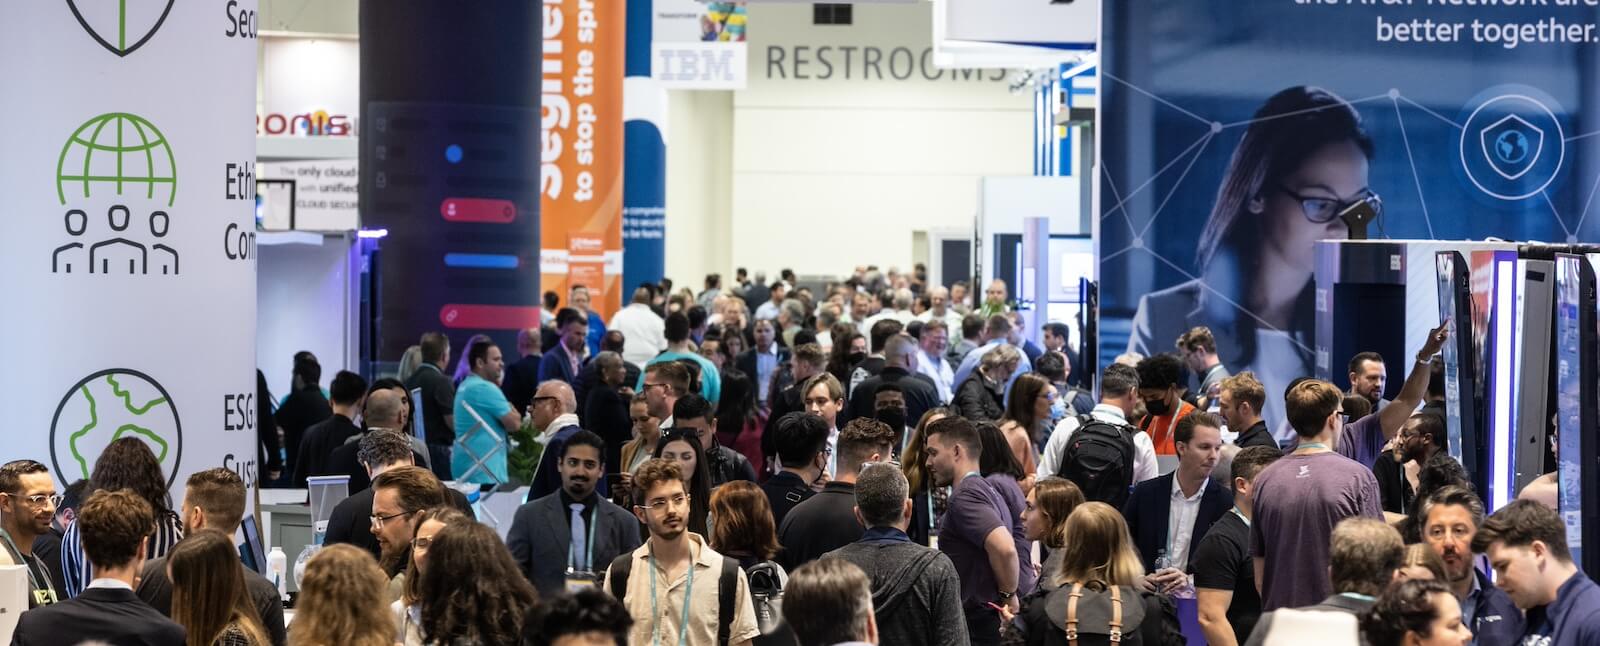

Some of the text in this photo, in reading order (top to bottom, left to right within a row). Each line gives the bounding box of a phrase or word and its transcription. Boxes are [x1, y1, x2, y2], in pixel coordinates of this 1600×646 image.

[1376, 15, 1600, 49] better together.
[571, 49, 595, 97] the
[659, 49, 735, 81] IBM
[572, 102, 598, 166] stop
[297, 164, 321, 180] only
[573, 170, 594, 202] to
